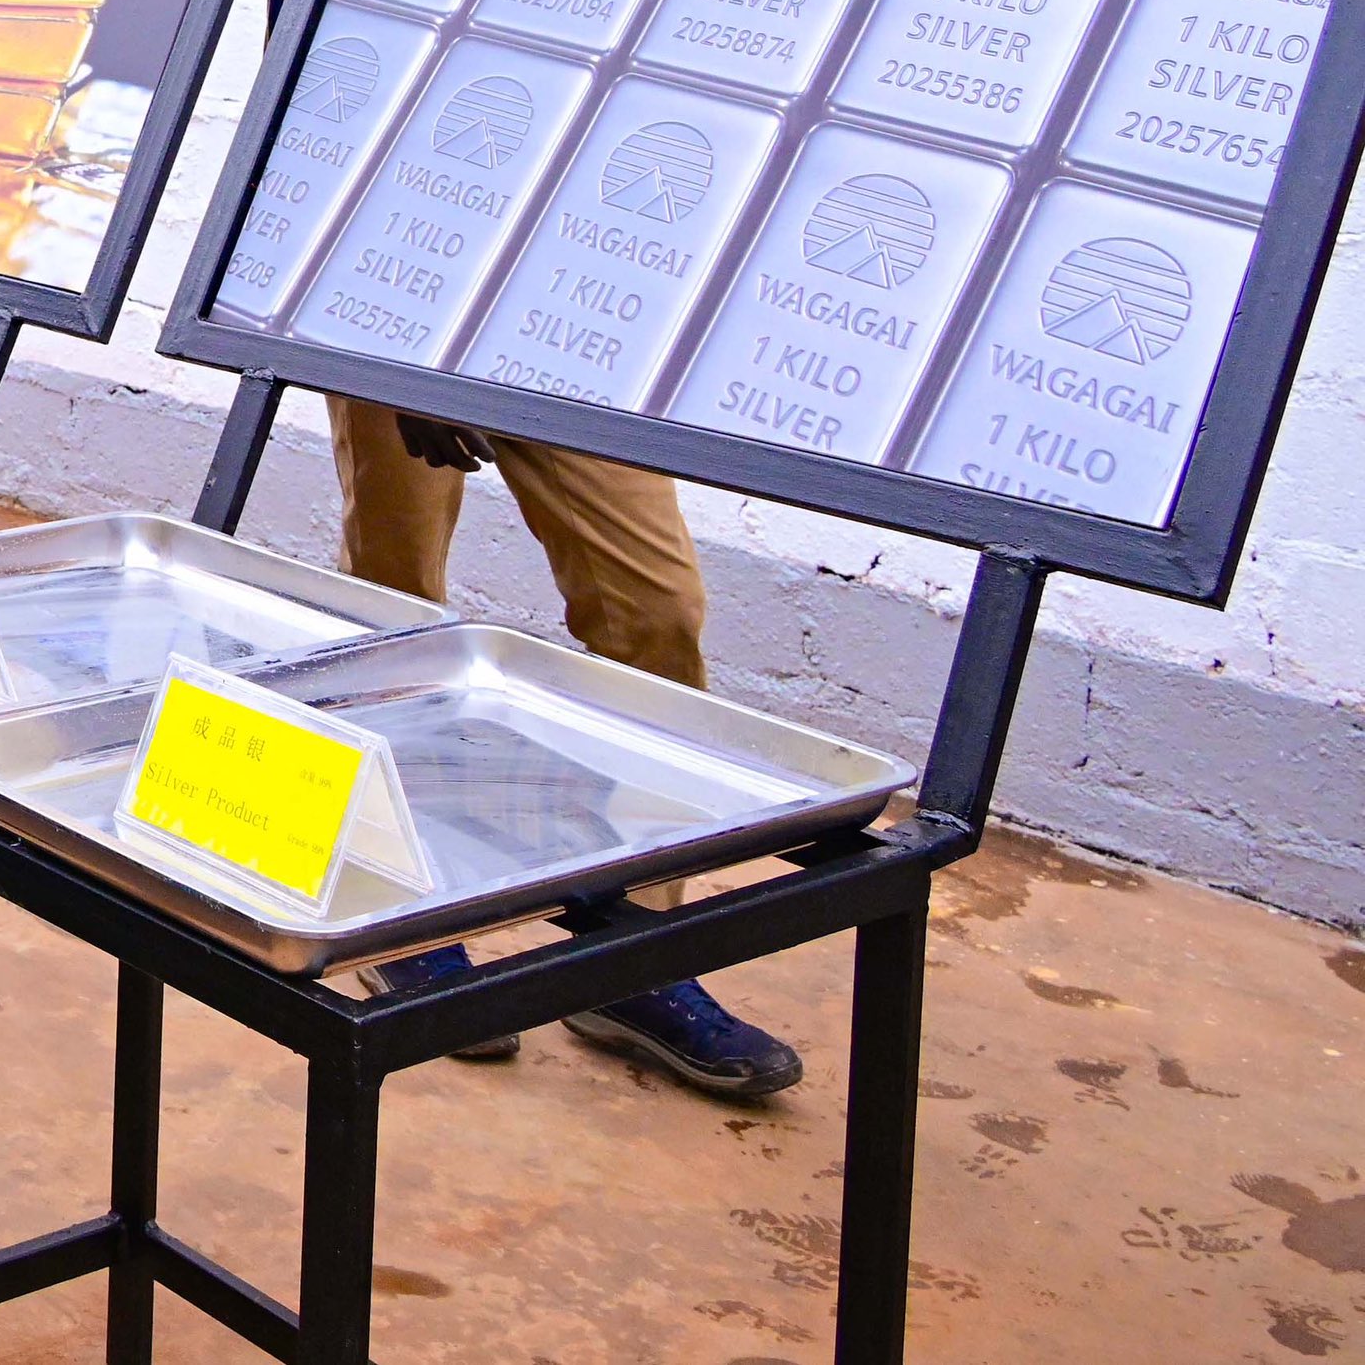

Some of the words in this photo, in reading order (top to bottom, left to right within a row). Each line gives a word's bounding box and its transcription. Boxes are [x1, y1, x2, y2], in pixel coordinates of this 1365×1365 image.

[672, 17, 796, 64] 20258874
[906, 13, 1031, 63] SILVER
[1210, 20, 1310, 65] KILO
[878, 59, 1023, 113] 20255386
[1149, 58, 1293, 116] SILVER
[394, 161, 511, 219] WAGAGAI
[401, 216, 465, 259] KILO
[558, 213, 692, 278] WAGAGAI
[354, 248, 444, 303] SILVER
[569, 275, 642, 322] KILO
[324, 291, 430, 350] 20257547
[519, 309, 622, 372] SILVER
[757, 273, 918, 351] WAGAGAI
[775, 343, 861, 398] KILO
[989, 344, 1181, 435] WAGAGAI
[718, 380, 843, 450] SILVER
[1017, 423, 1117, 484] KILO
[193, 715, 266, 762] 成品银
[145, 762, 199, 799] Silver
[206, 787, 270, 831] Product
